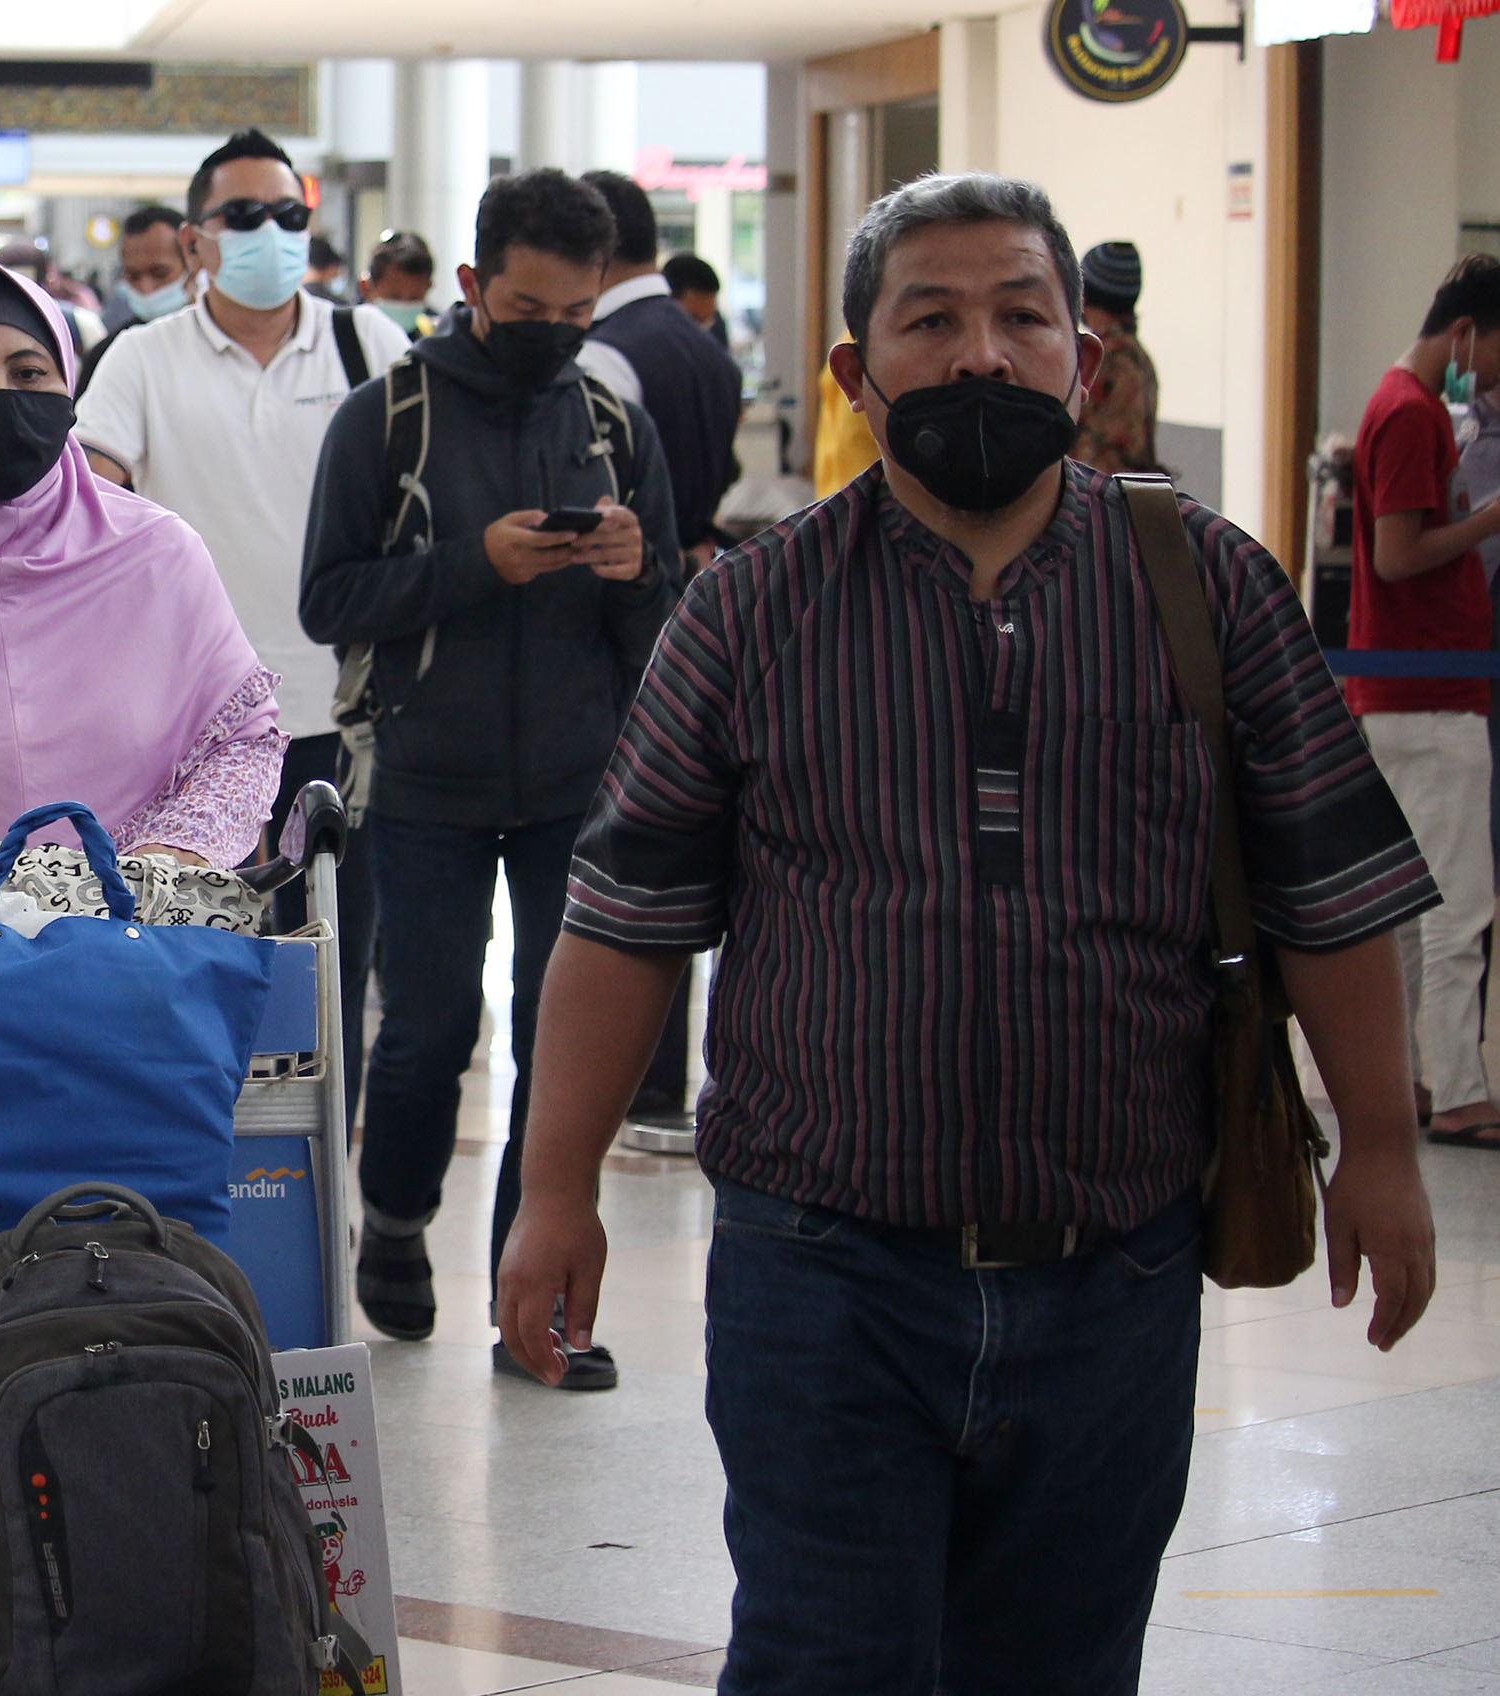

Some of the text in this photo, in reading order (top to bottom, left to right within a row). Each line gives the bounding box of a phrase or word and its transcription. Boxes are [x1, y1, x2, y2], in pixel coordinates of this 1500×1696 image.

[227, 1178, 286, 1199] andiri
[279, 1372, 355, 1399] S MALANG
[306, 1495, 358, 1511] donesia
